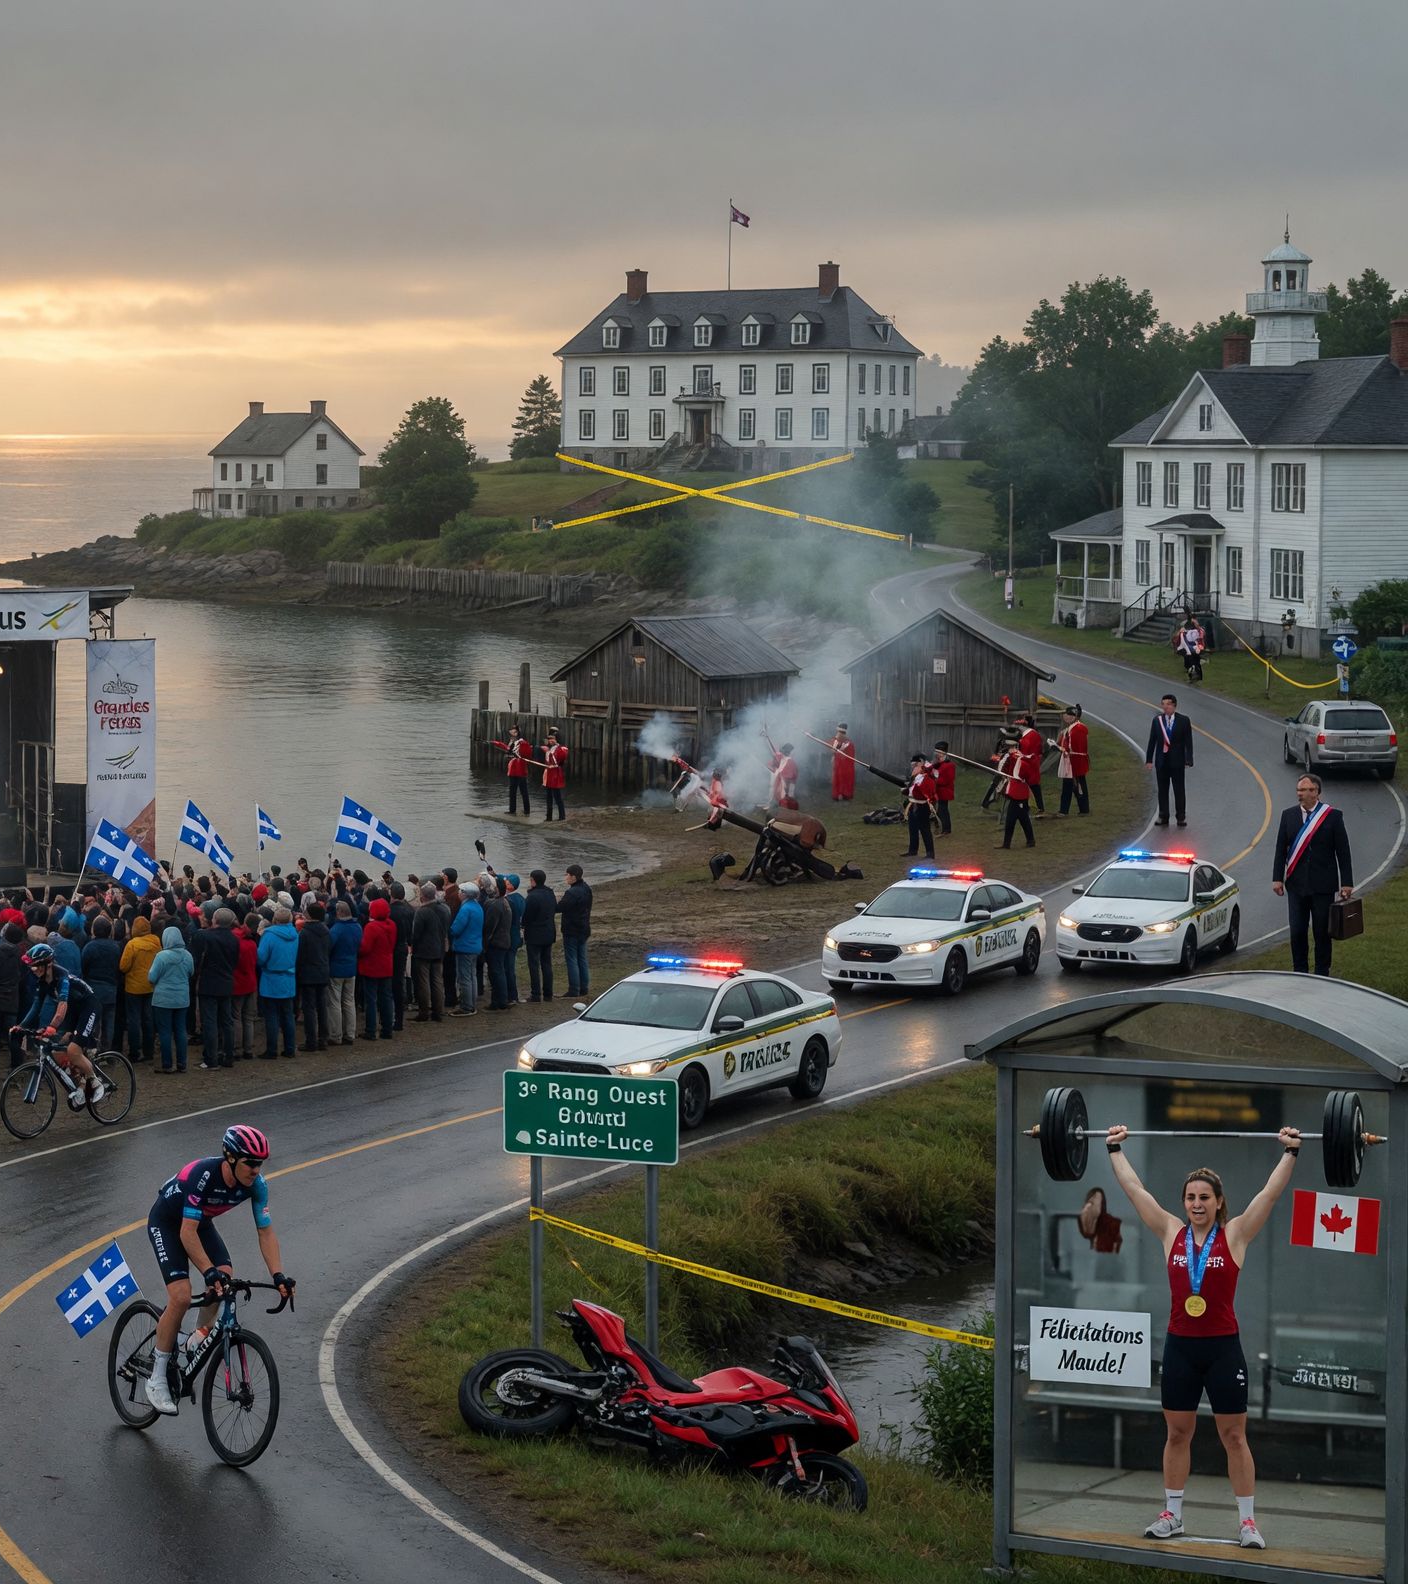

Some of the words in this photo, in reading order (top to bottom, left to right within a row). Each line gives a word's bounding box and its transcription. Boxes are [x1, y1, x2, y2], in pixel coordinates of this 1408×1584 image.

[548, 1082, 598, 1106] Rang
[609, 1086, 667, 1106] Ouest
[535, 1128, 654, 1152] Sainte-Luce
[1039, 1318, 1144, 1345] Félicitations
[1057, 1349, 1127, 1375] Maude!
